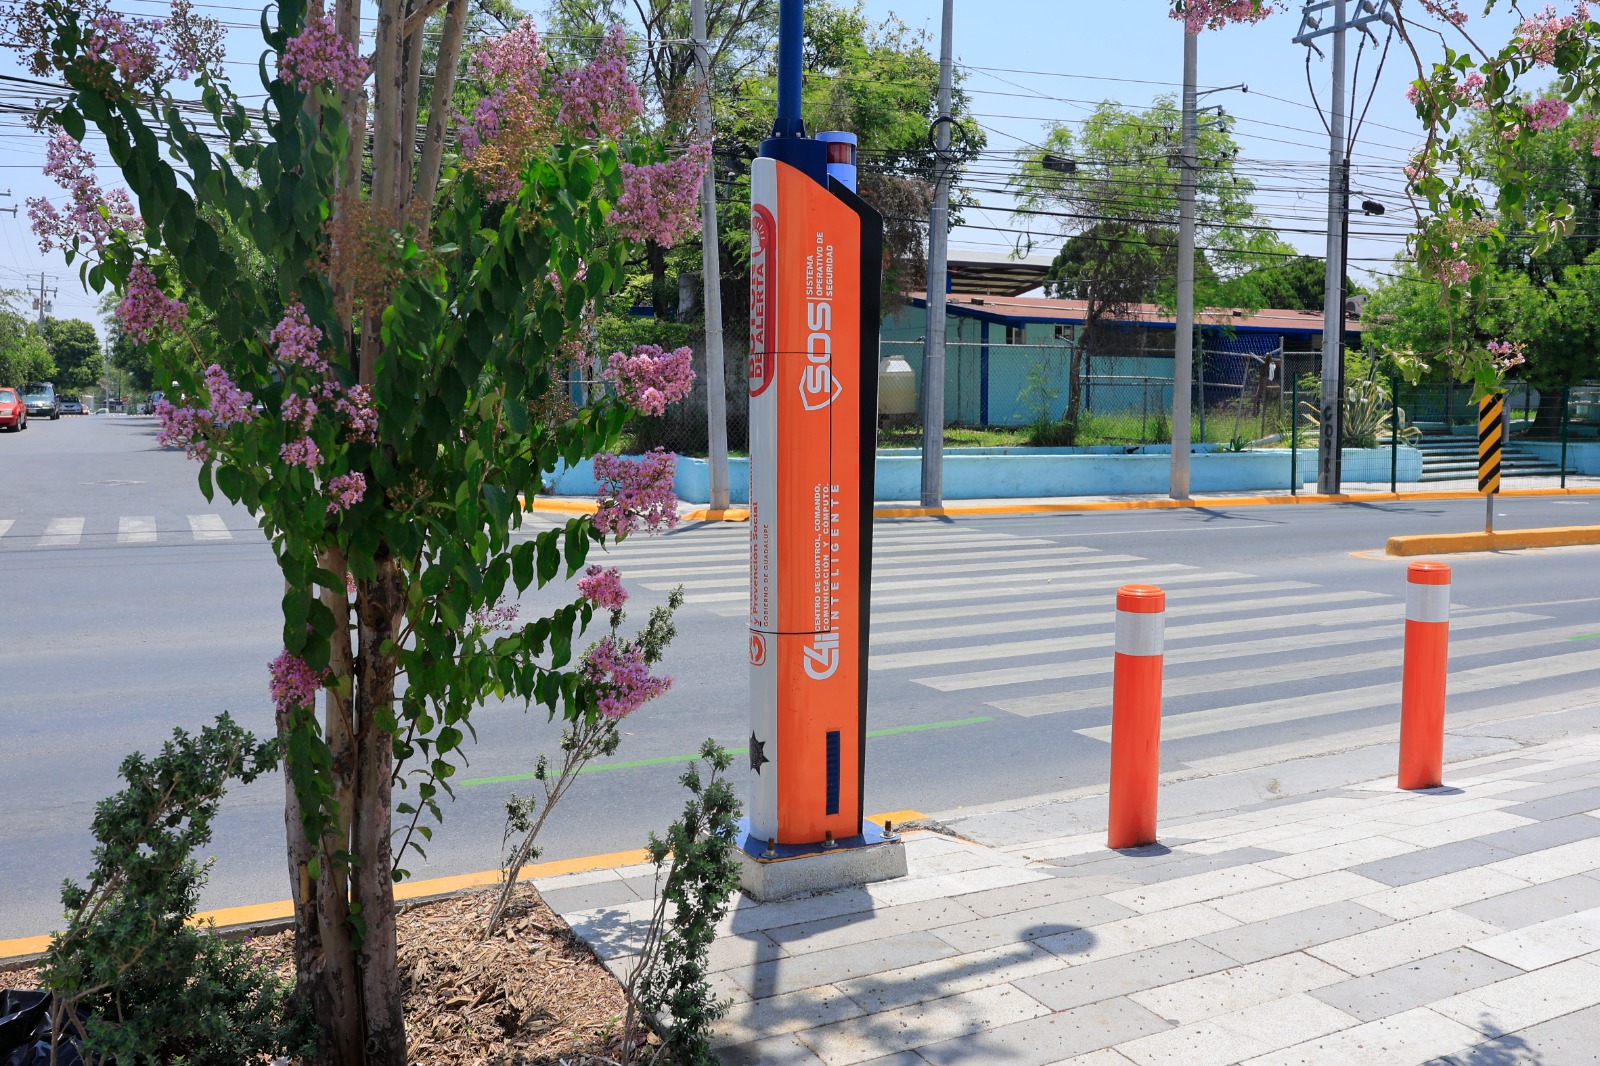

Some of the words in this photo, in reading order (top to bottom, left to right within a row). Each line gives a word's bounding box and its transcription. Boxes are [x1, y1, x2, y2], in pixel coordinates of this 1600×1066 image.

[816, 232, 823, 244] DE
[755, 263, 764, 345] ALERTA
[755, 354, 763, 378] DE
[807, 302, 832, 394] SOS
[814, 483, 822, 532] COMANDO,
[763, 573, 769, 583] DE
[814, 533, 822, 579] CONTROL,
[830, 484, 839, 631] INTELIGENTE
[814, 581, 821, 593] DE
